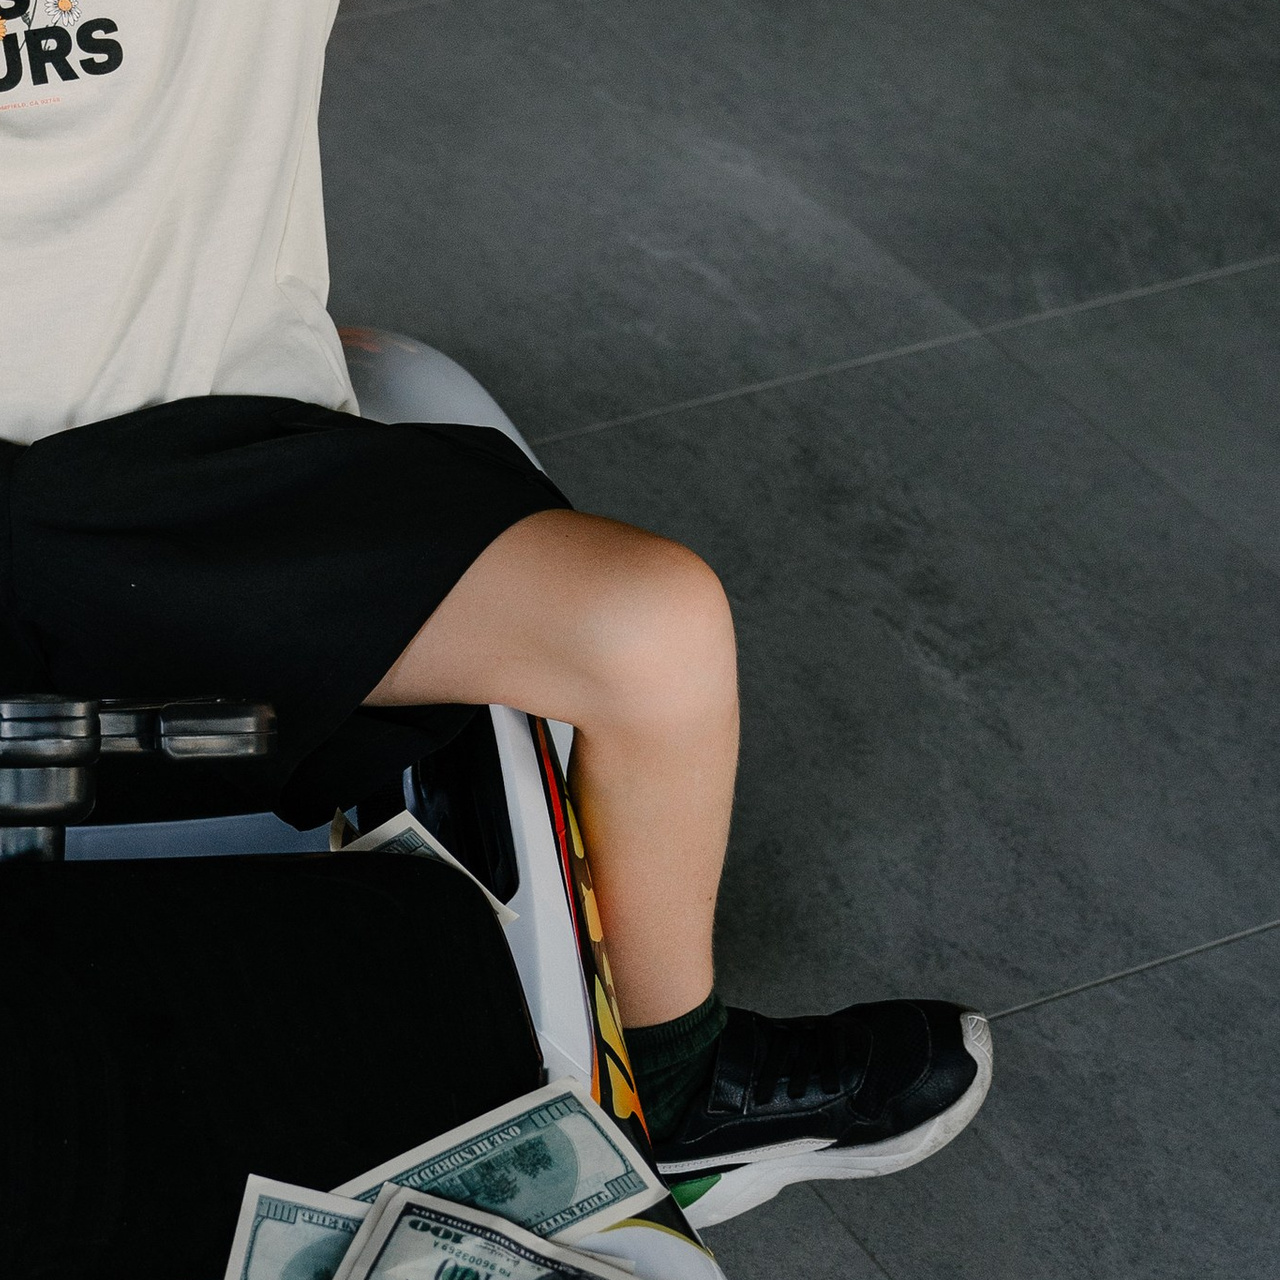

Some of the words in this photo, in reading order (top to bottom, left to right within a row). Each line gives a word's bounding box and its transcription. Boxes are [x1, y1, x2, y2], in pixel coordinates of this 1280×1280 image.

[487, 1121, 522, 1148] ONE
[418, 1136, 492, 1183] HUNDRED
[407, 1216, 465, 1245] 100
[527, 1205, 578, 1238] UNITE
